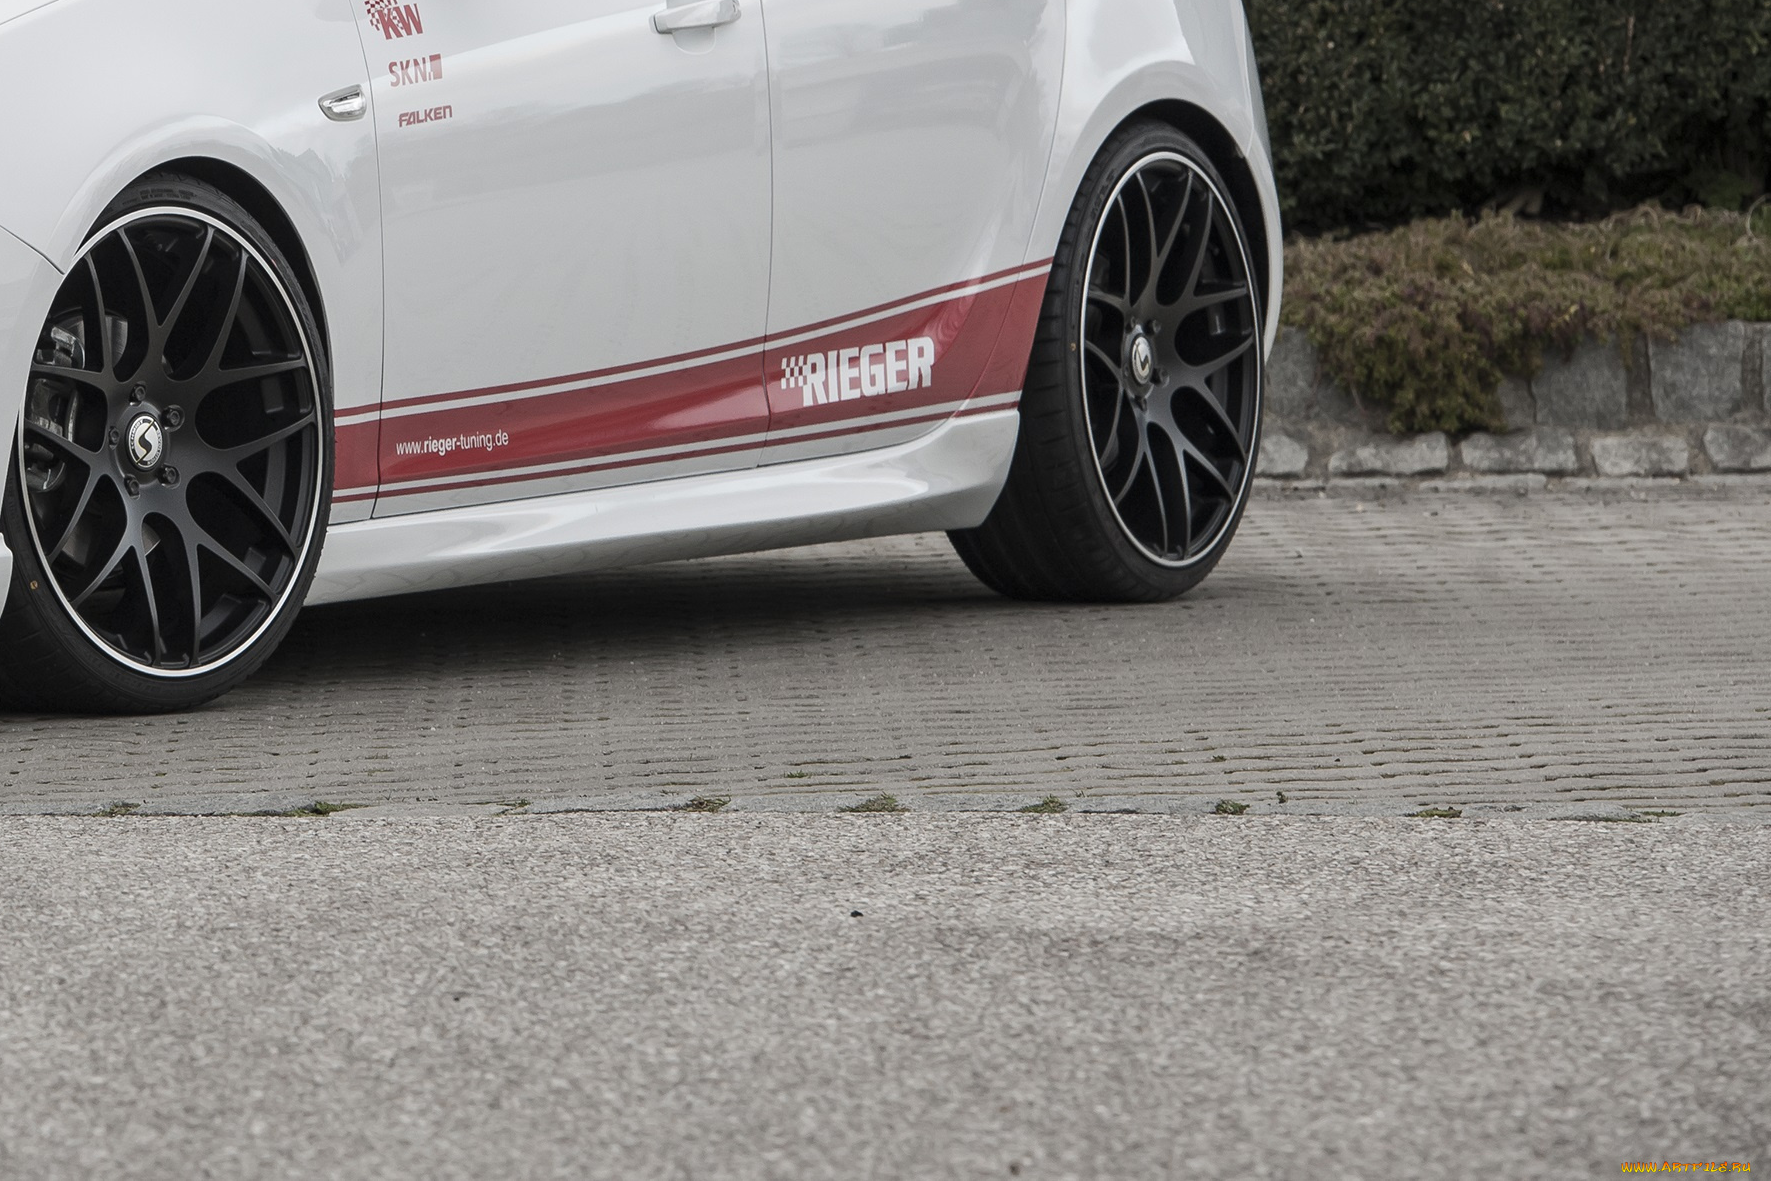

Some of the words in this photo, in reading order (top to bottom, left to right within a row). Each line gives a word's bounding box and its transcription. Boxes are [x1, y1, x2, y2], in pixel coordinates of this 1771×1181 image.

[378, 3, 423, 40] KW
[398, 105, 453, 128] FALKEN
[802, 336, 935, 407] RIEGER
[396, 429, 509, 456] www.rieger-tuning.de
